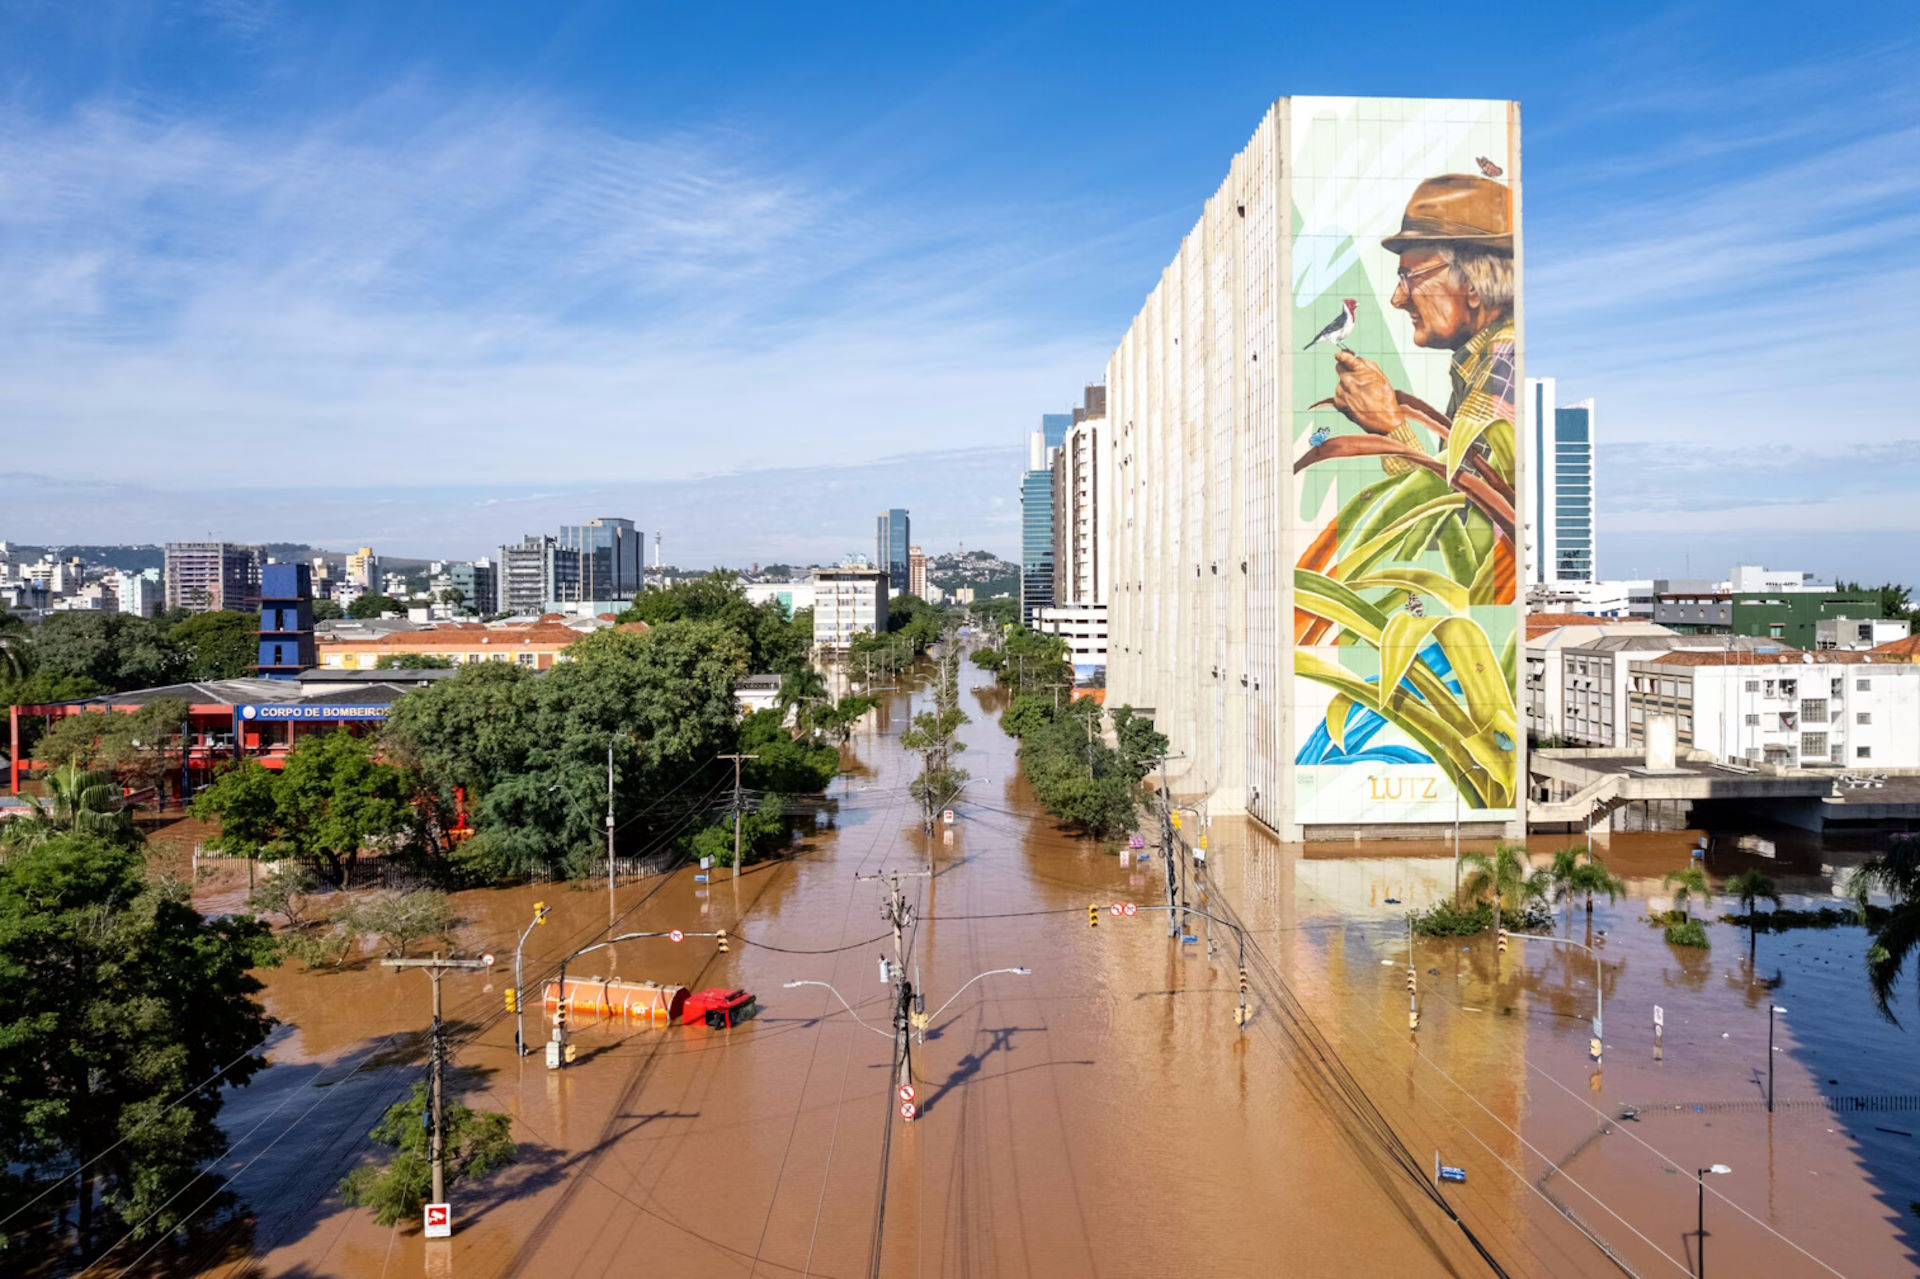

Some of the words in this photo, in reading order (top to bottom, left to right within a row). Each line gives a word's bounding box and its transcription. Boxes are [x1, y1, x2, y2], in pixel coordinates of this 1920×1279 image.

[261, 707, 302, 717] CORPO
[305, 707, 320, 717] DE
[323, 707, 391, 717] BOMBEIROS
[1370, 777, 1437, 800] LUTZ
